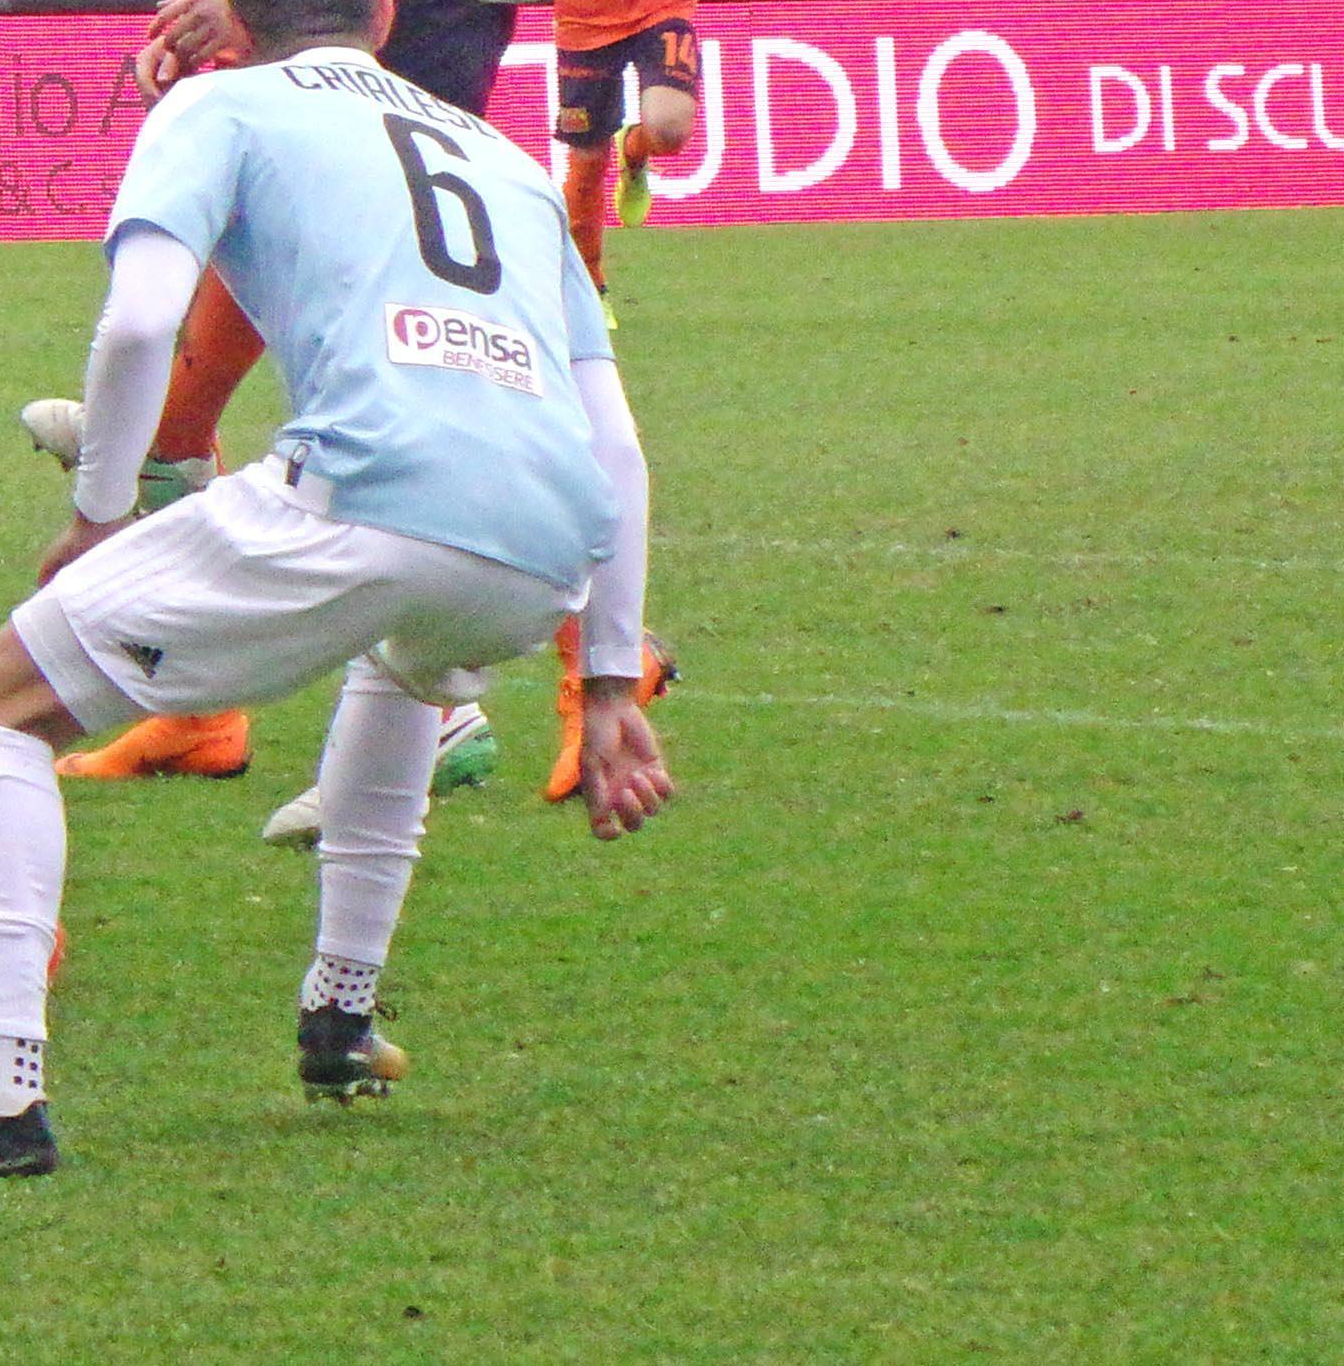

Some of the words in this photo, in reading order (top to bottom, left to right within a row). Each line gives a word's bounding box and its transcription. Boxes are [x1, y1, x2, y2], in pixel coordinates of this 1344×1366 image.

[1090, 65, 1176, 155] DI
[383, 112, 502, 296] 6
[393, 307, 533, 372] pensa
[442, 349, 534, 392] BENESSERE
